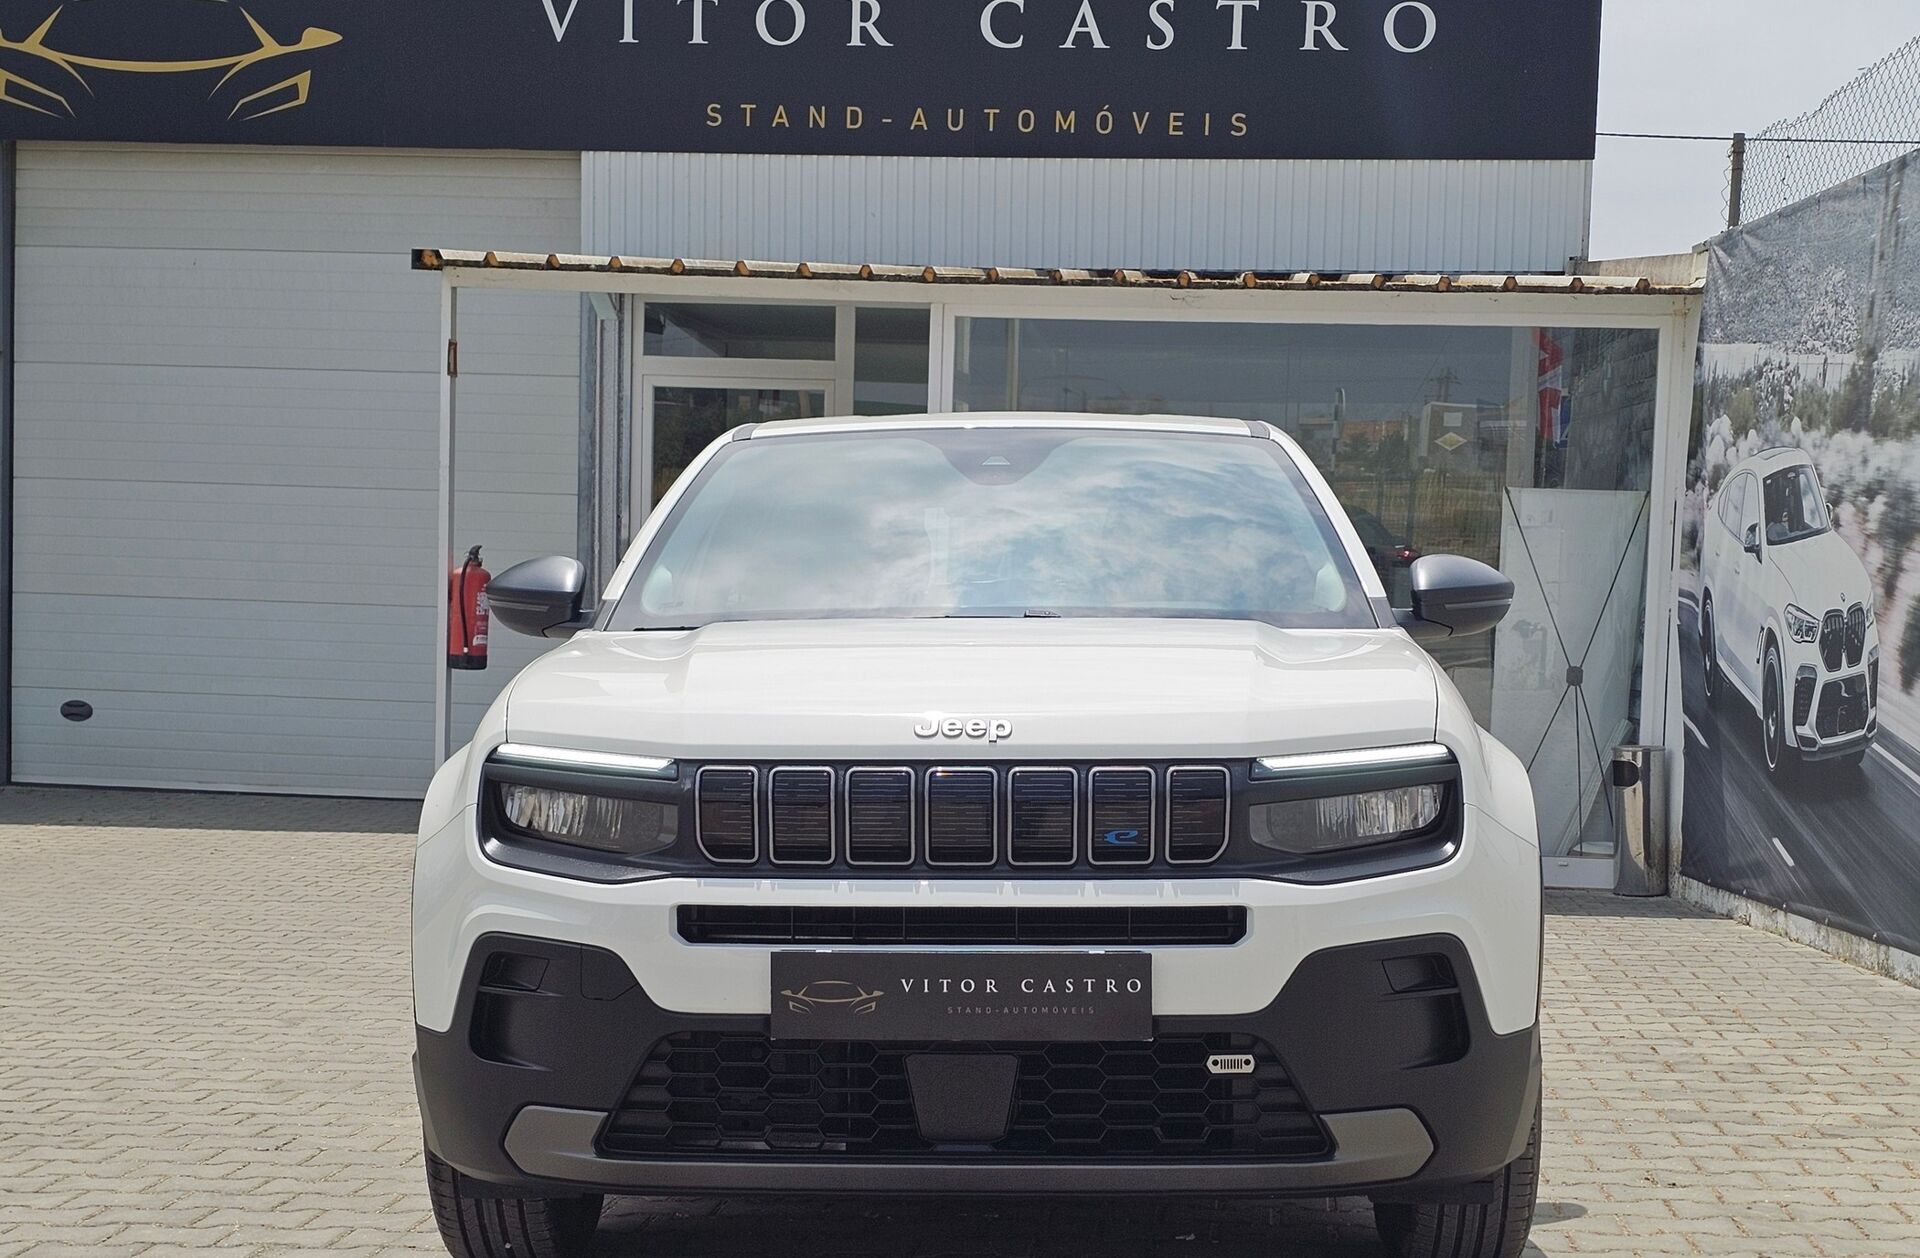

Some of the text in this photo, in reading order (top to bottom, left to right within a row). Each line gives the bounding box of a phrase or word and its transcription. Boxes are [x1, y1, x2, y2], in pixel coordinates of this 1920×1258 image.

[541, 0, 1438, 53] VITOR CASTRO
[705, 102, 1251, 138] STAND-AUTOMÓVEIS
[913, 714, 1013, 743] Jeep
[901, 978, 1143, 993] VITOR CASTRO
